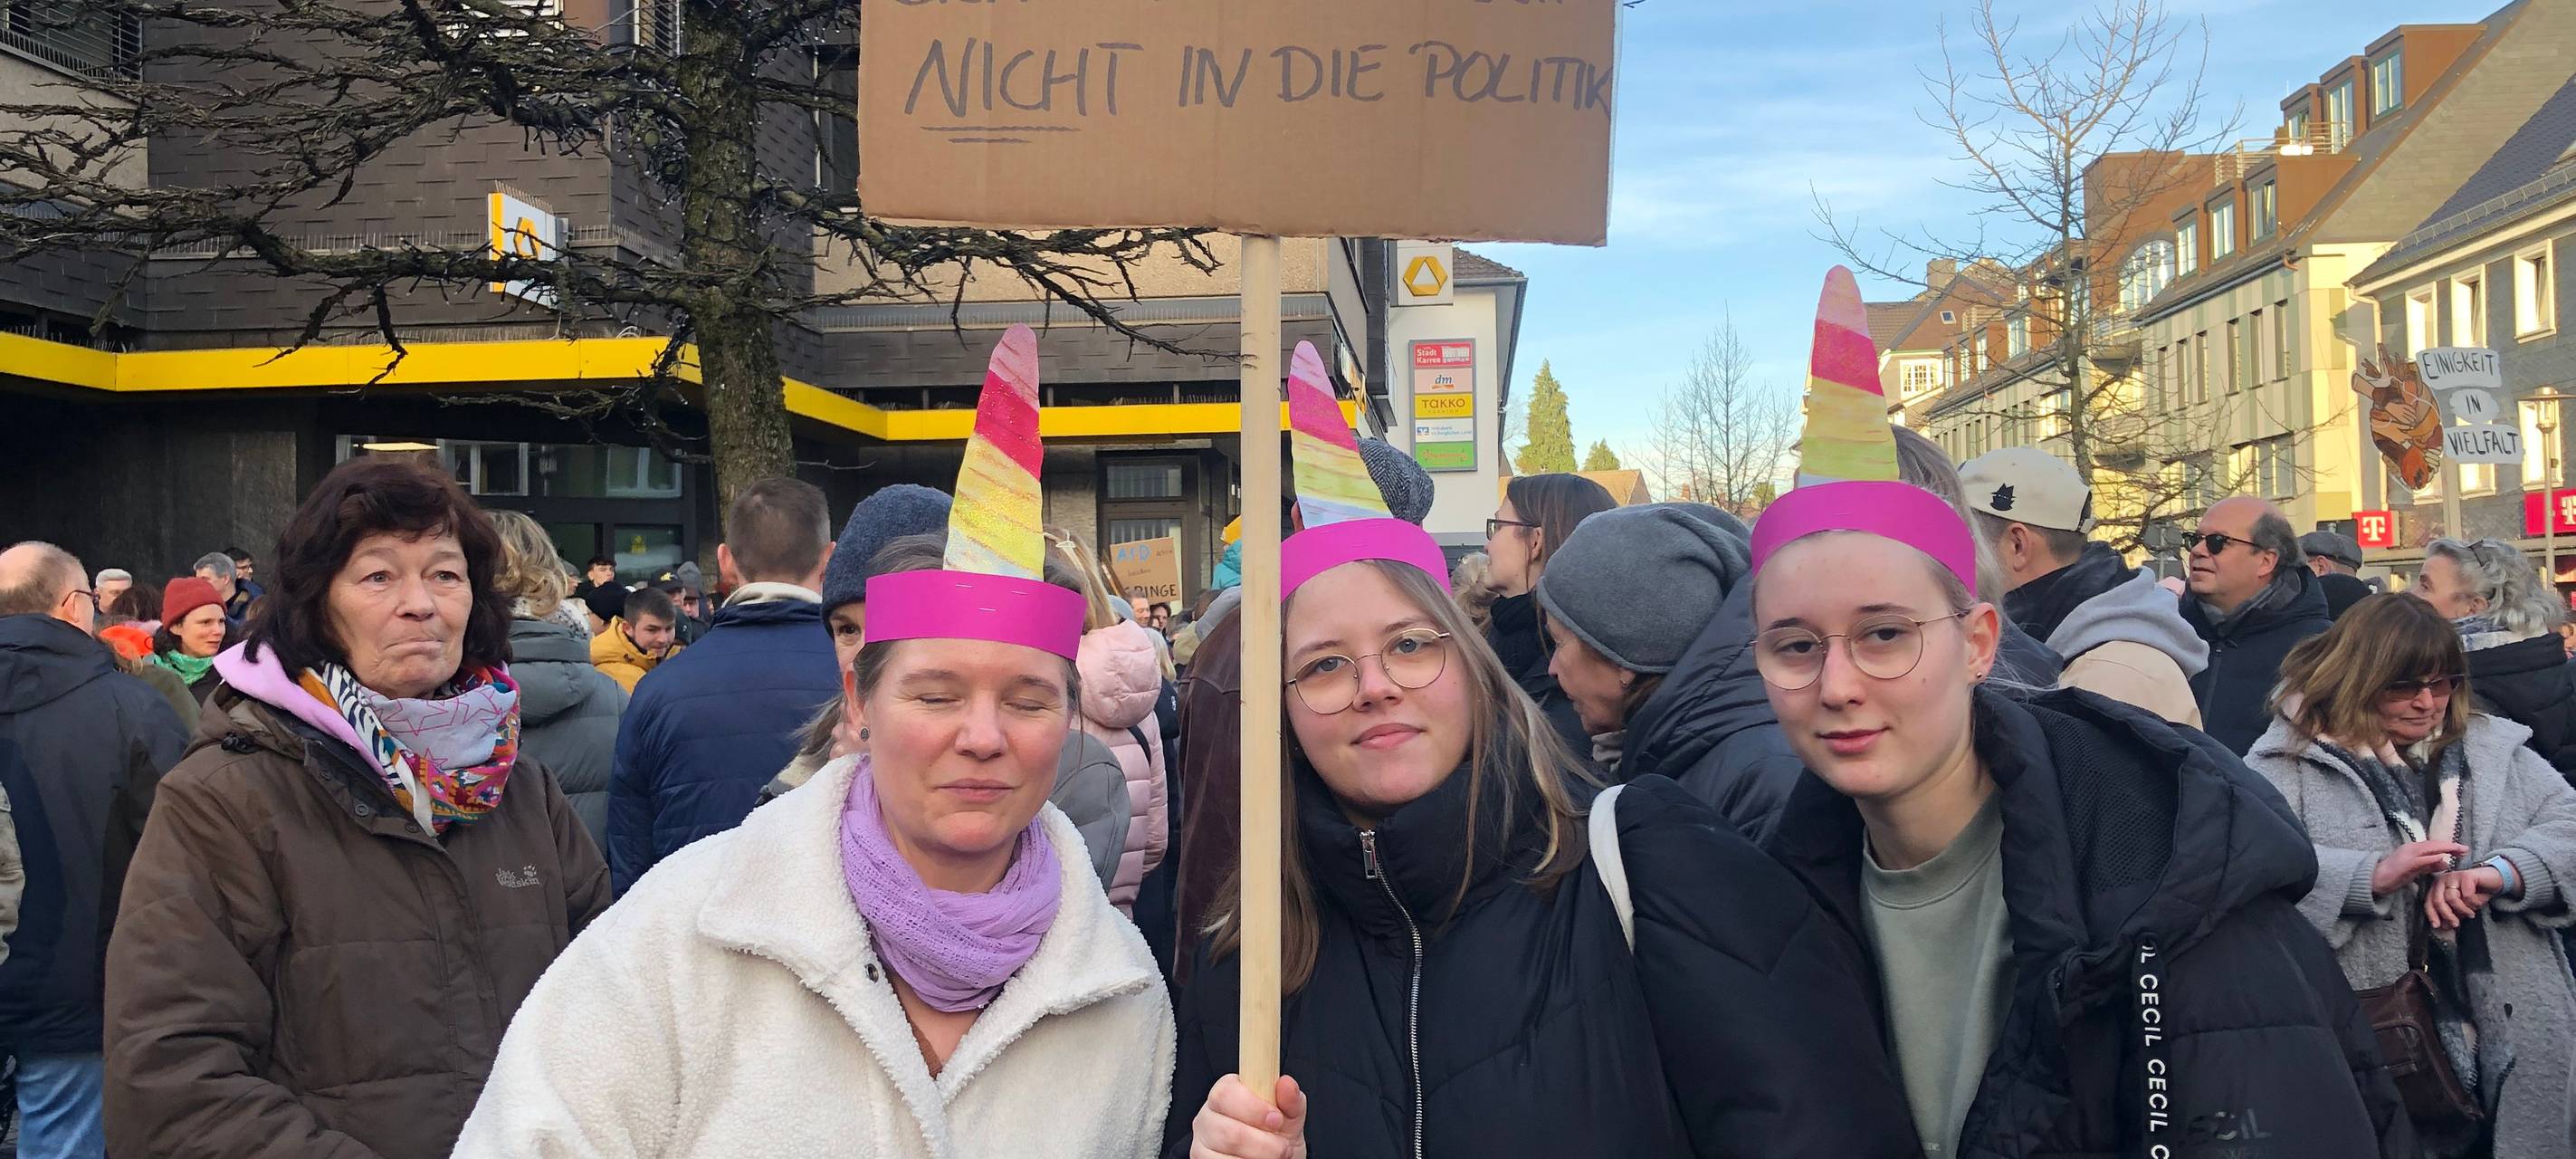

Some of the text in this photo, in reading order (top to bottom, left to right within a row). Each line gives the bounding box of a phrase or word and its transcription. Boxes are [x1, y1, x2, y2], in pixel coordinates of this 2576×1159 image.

[904, 37, 1614, 121] NICHT IN DIE POLITIK
[2422, 350, 2495, 379] EINIGKEIT
[1435, 374, 1453, 385] dm
[2466, 395, 2482, 415] IN
[2447, 430, 2518, 455] VIELFALT
[2362, 516, 2386, 541] T
[2140, 973, 2162, 1047] CECIL
[2148, 1058, 2169, 1132] CECIL
